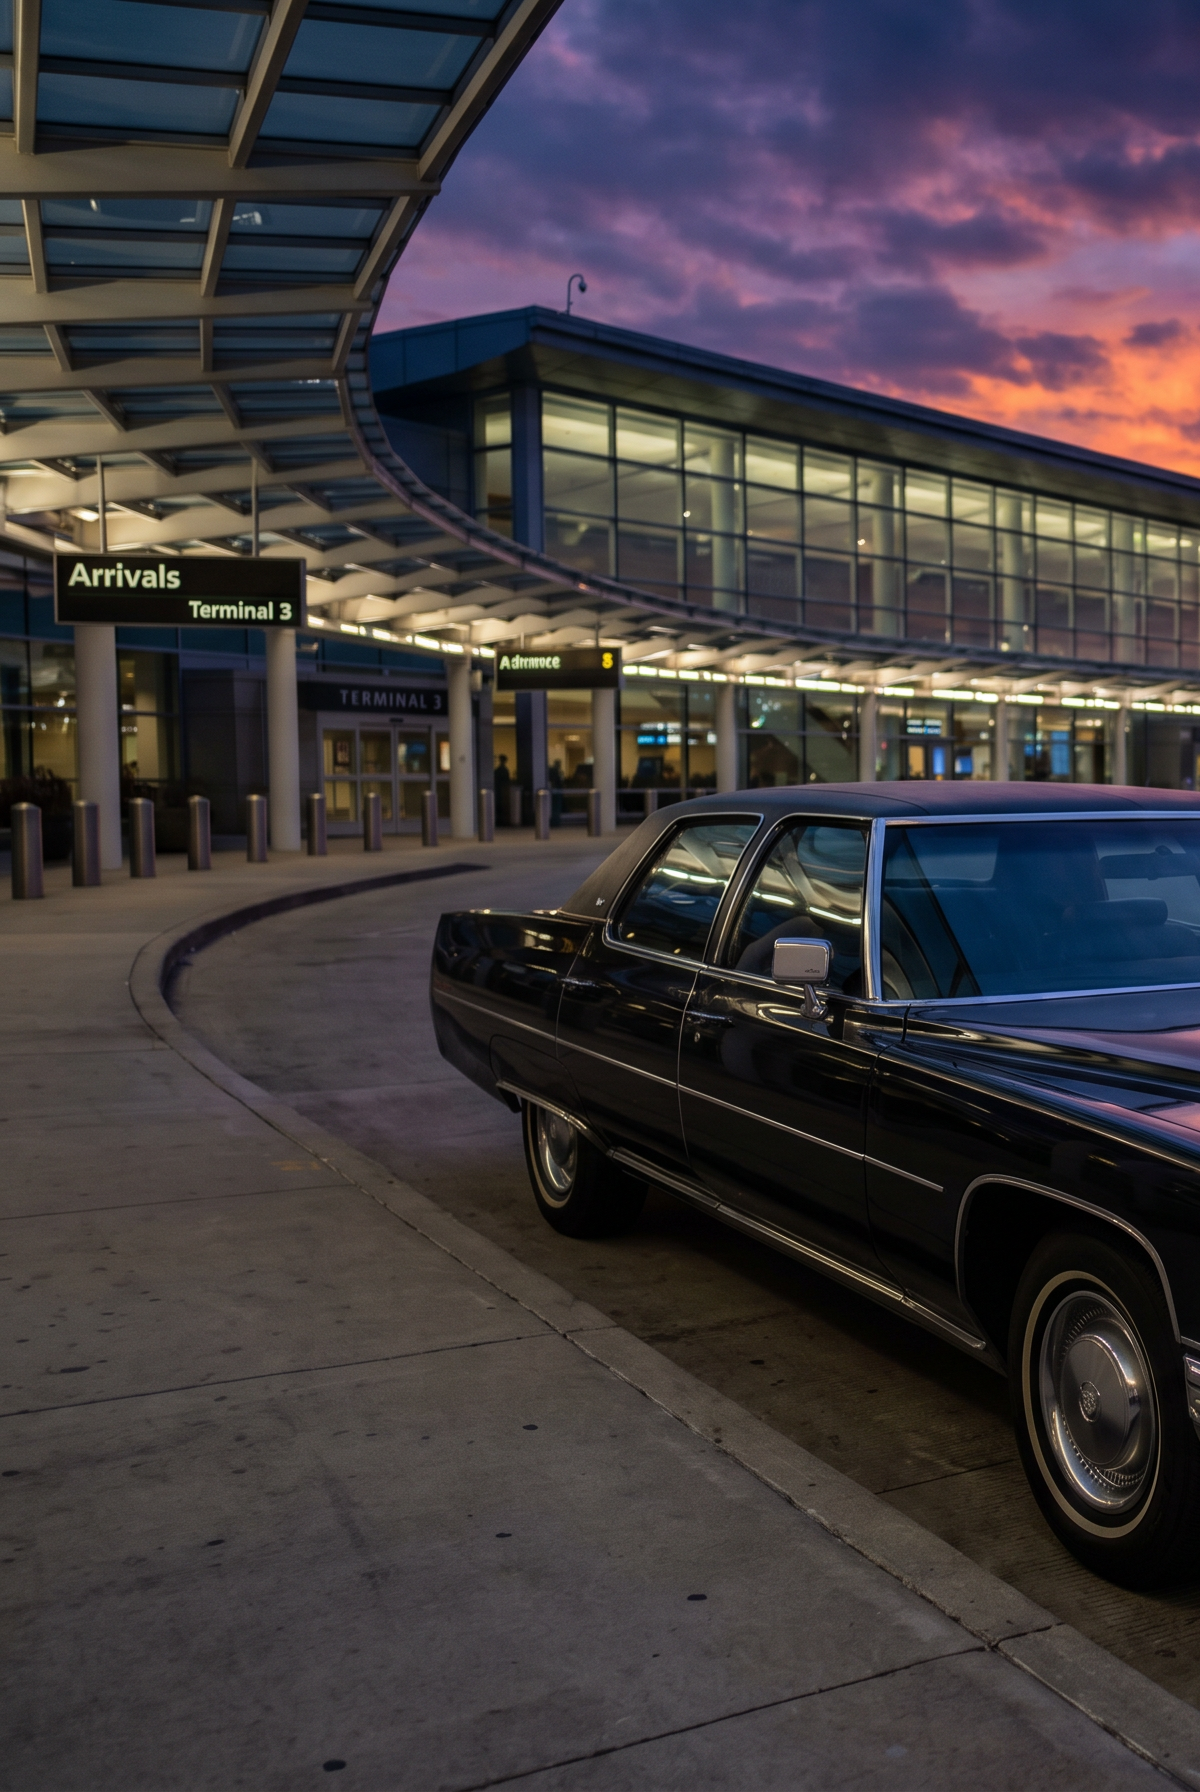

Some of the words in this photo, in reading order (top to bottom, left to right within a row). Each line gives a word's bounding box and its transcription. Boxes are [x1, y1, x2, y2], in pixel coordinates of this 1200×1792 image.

[67, 562, 181, 589] Arrivals
[188, 600, 274, 620] Terminal
[279, 602, 293, 621] 3
[340, 689, 428, 709] TERMINAL
[433, 694, 442, 710] 3
